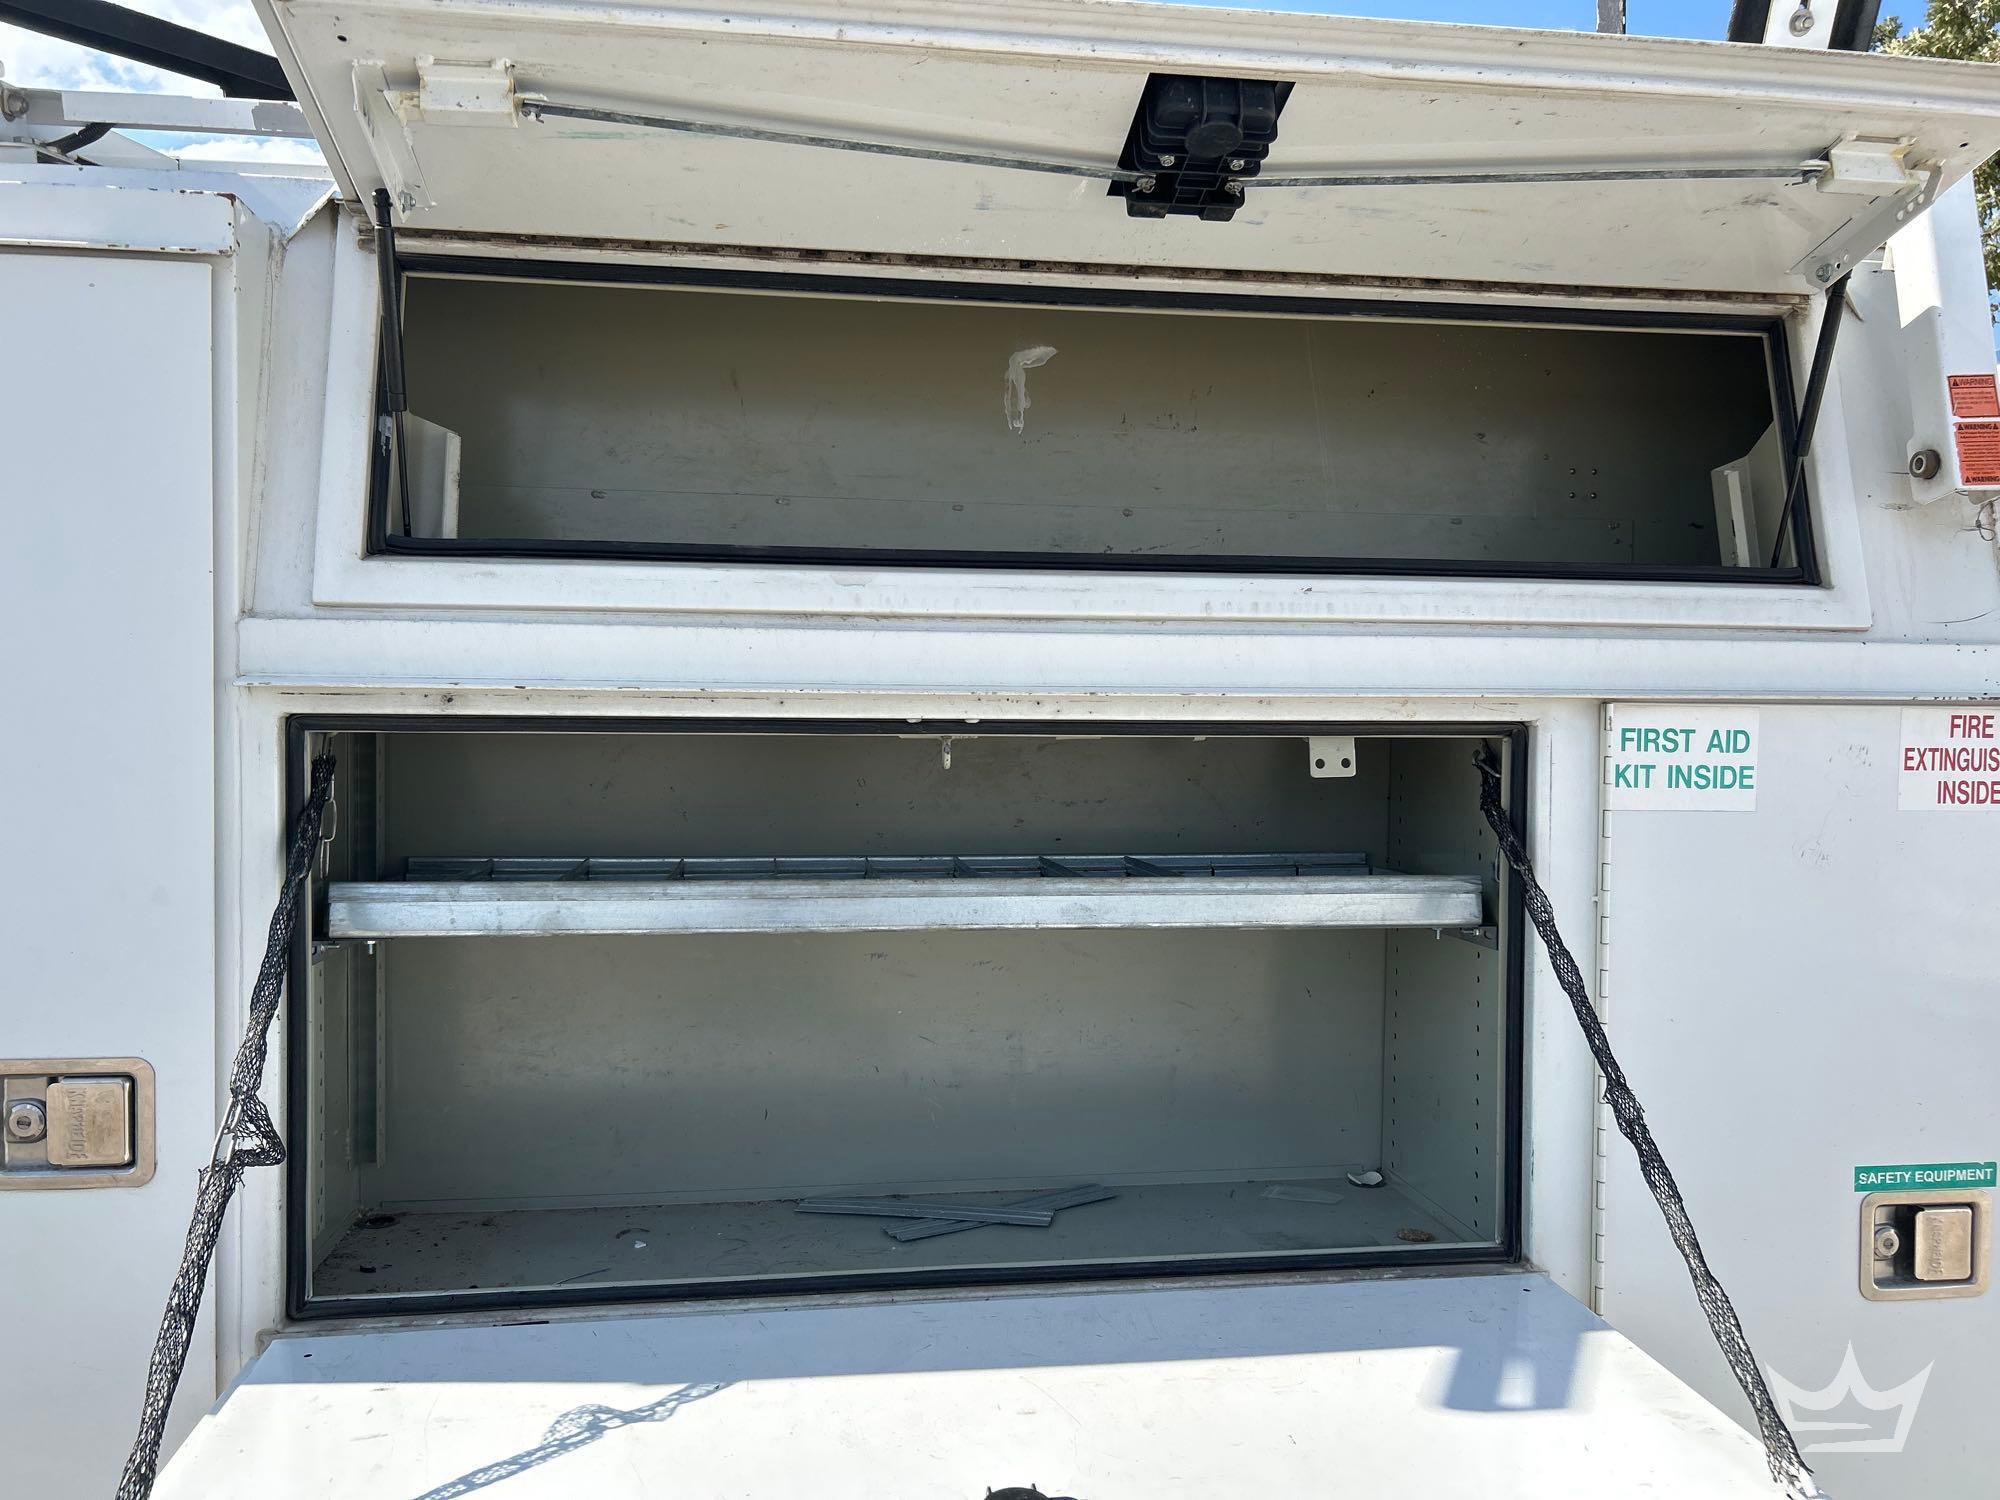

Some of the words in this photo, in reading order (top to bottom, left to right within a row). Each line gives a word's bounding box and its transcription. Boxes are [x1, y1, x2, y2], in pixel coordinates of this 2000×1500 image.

[1960, 378, 1993, 386] WARNING
[1964, 423, 1992, 431] WARNING
[1971, 475, 2000, 483] WARNING
[1949, 714, 1995, 738] FIRE
[1620, 728, 1696, 753] FIRST
[1706, 729, 1750, 754] AID
[1614, 764, 1656, 789] KIT
[1667, 764, 1754, 790] INSIDE
[1937, 780, 2000, 805] INSIDE
[1858, 1171, 1912, 1185] SAFETY
[1915, 1168, 1993, 1183] EQUIPMENT
